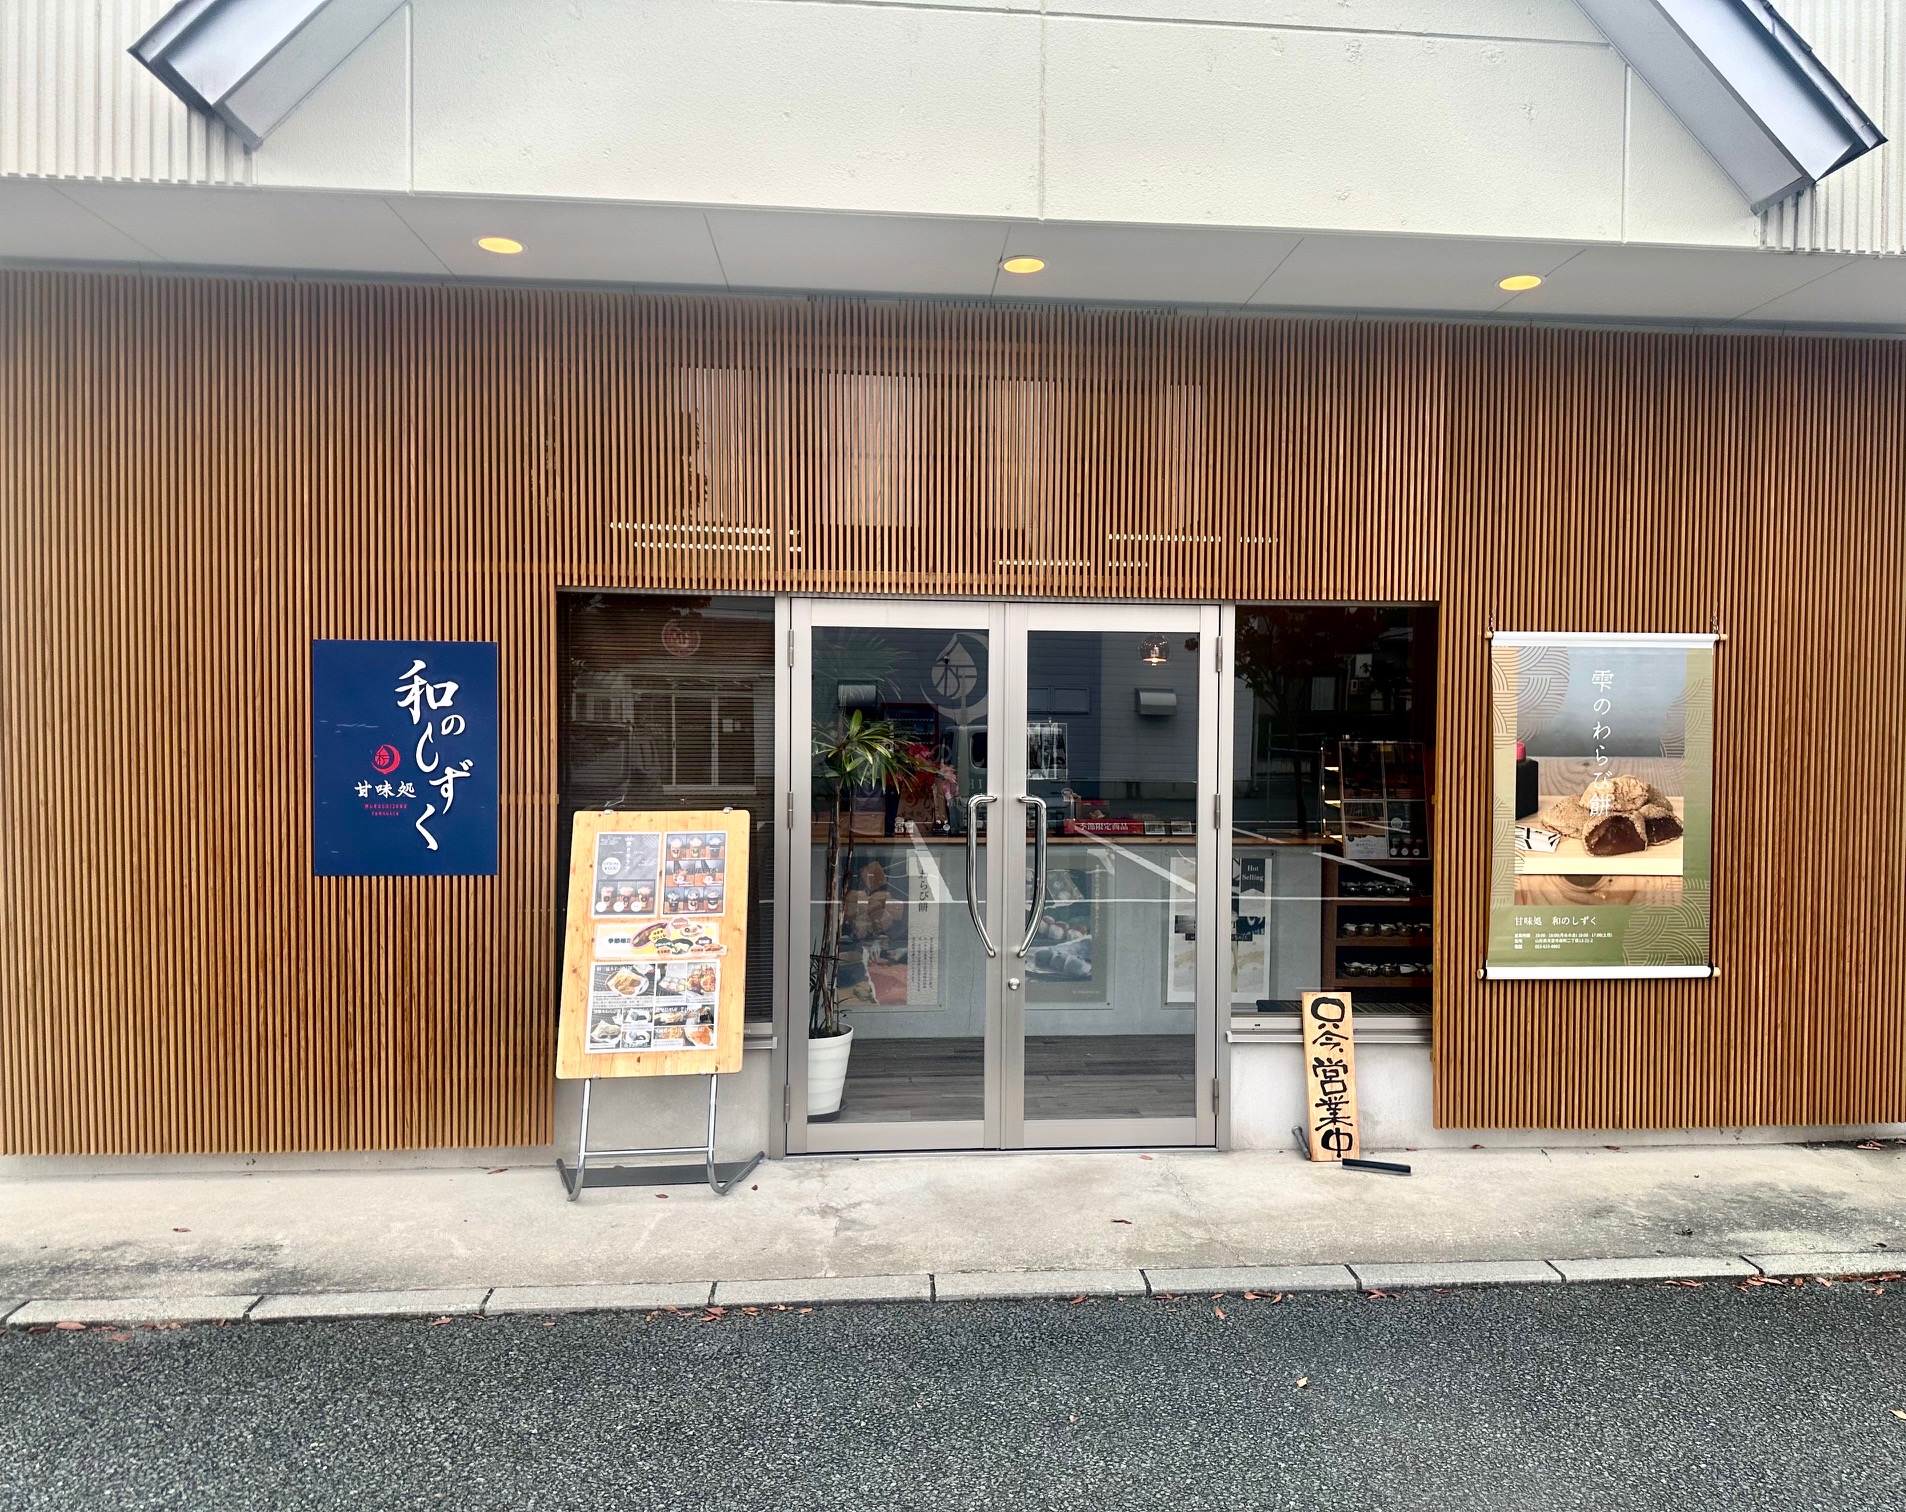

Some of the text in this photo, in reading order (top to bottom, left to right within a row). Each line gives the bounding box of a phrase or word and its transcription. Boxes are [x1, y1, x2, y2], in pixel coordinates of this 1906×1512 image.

[394, 659, 474, 851] 和のしずく
[1589, 669, 1615, 818] 雫のわらび餅
[354, 780, 417, 799] 甘味処
[1080, 821, 1129, 831] 季節限定商品
[918, 869, 929, 913] わらび餅
[1242, 874, 1264, 882] Selling
[1514, 915, 1597, 926] 甘味処 和のしずく
[1310, 996, 1354, 1158] 只今営業中
